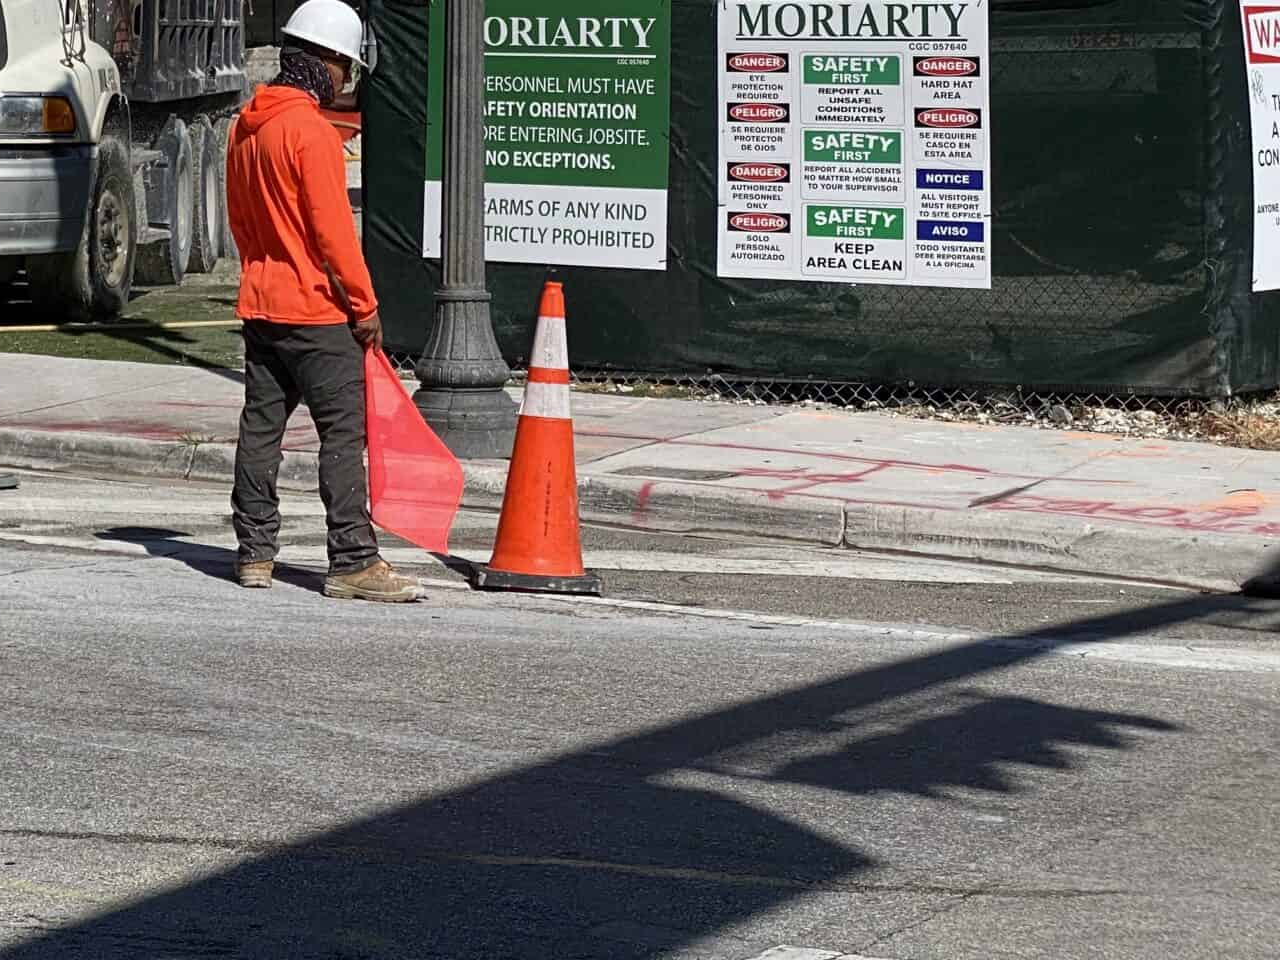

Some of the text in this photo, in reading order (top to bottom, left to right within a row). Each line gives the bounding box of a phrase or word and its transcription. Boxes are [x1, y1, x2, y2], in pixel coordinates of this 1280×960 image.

[735, 3, 968, 38] MORIARTY
[908, 43, 967, 51] CGC 057640
[734, 57, 781, 67] DANGER
[811, 56, 889, 72] SAFETY
[922, 62, 971, 71] DANGER
[831, 73, 869, 83] FIRST
[483, 76, 655, 95] ERSONNEL MUST HAVE
[731, 83, 784, 91] PROTECTION
[921, 80, 973, 88] HARD HAT
[483, 100, 637, 120] FETY ORIENTATION
[735, 108, 784, 117] PELIGRO
[815, 115, 886, 123] IMMEDIATELY
[923, 113, 974, 122] PELIGRO
[744, 126, 786, 134] REQUIERE
[1272, 121, 1280, 138] A
[510, 126, 583, 144] ENTERING
[587, 128, 650, 146] JOBSITE.
[933, 132, 976, 140] REQUIERE
[811, 133, 894, 152] SAFETY
[485, 150, 616, 170] NO EXCEPTIONS.
[834, 150, 871, 160] FIRST
[1258, 148, 1280, 166] CON
[735, 167, 782, 177] DANGER
[925, 174, 970, 184] NOTICE
[731, 184, 784, 192] AUTHORIZED
[845, 184, 898, 192] SUPERVISOR
[732, 193, 782, 201] PERSONNEL
[484, 198, 647, 221] ARMS OF ANY KIND
[735, 217, 784, 228] PELIGRO
[814, 208, 896, 228] SAFETY
[836, 225, 873, 236] FIRST
[932, 225, 968, 236] AVISO
[552, 228, 655, 249] PROHIBITED
[735, 243, 781, 251] PERSONAL
[834, 242, 874, 254] KEEP
[942, 245, 985, 253] VISITANTE
[731, 252, 785, 260] AUTORIZADO
[937, 253, 985, 261] REPORTARSE
[806, 257, 902, 271] AREA CLEAN
